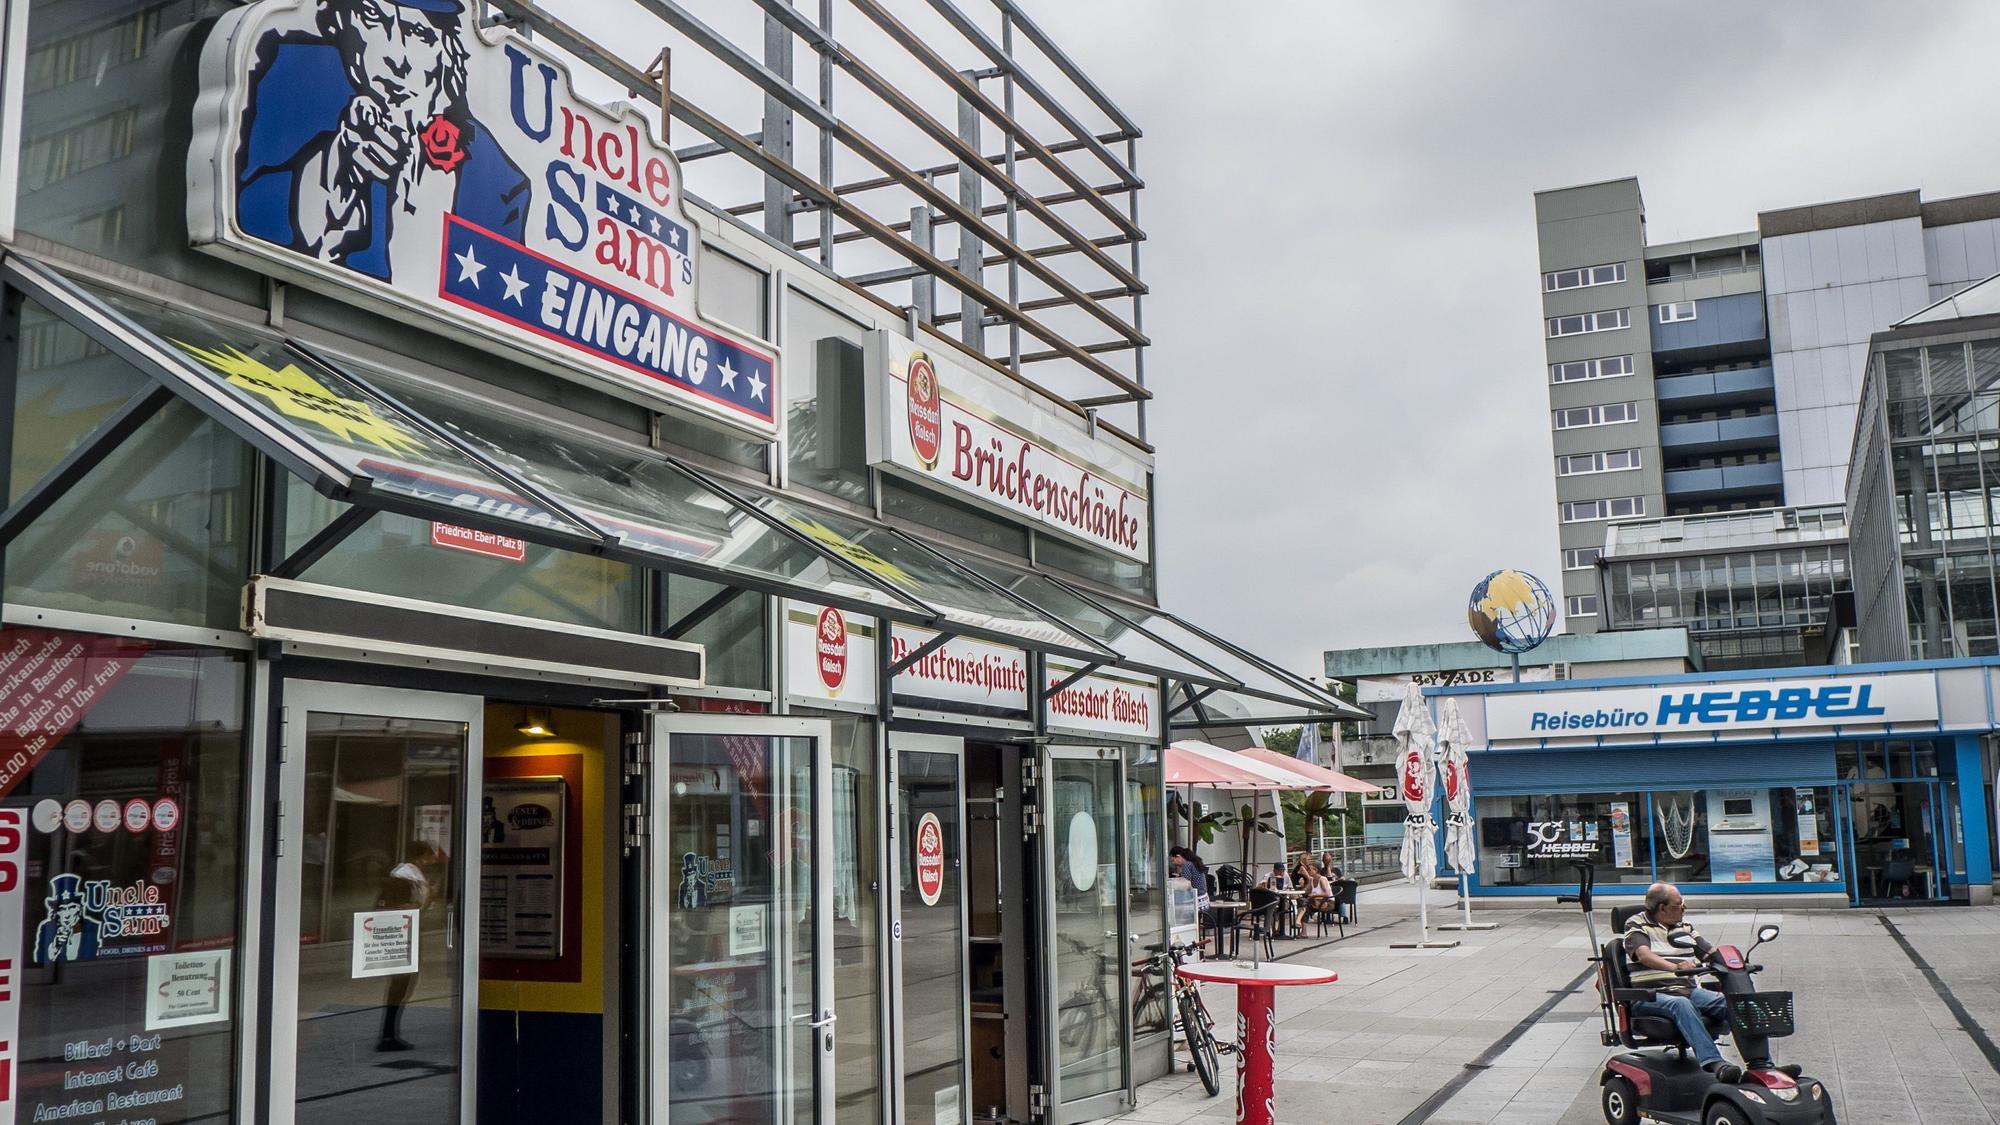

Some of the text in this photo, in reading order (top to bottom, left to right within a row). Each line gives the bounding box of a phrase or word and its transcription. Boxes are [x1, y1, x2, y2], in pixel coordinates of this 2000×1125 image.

[504, 44, 670, 207] Uncle
[540, 270, 708, 386] EINGANG
[909, 397, 940, 424] Reissdorf
[952, 420, 1138, 550] Brückenschänke
[436, 523, 473, 540] Friedrich
[497, 536, 516, 549] Platz
[517, 540, 522, 550] 9
[18, 691, 33, 707] in
[31, 643, 85, 693] Bestform
[15, 677, 78, 738] täglich von
[24, 734, 47, 756] bis
[44, 705, 74, 736] 5.00
[71, 684, 96, 709] Uhr
[94, 660, 121, 687] früh
[1112, 686, 1148, 731] Kölsch
[1531, 684, 1885, 731] Reisebüro HEBBEL
[1541, 842, 1599, 852] HEBBEL
[85, 880, 159, 912] Uncle
[64, 1038, 113, 1061] Billard
[130, 1034, 161, 1051] Dart
[64, 1060, 159, 1090] Internet Café
[33, 1084, 183, 1123] American Restaurant
